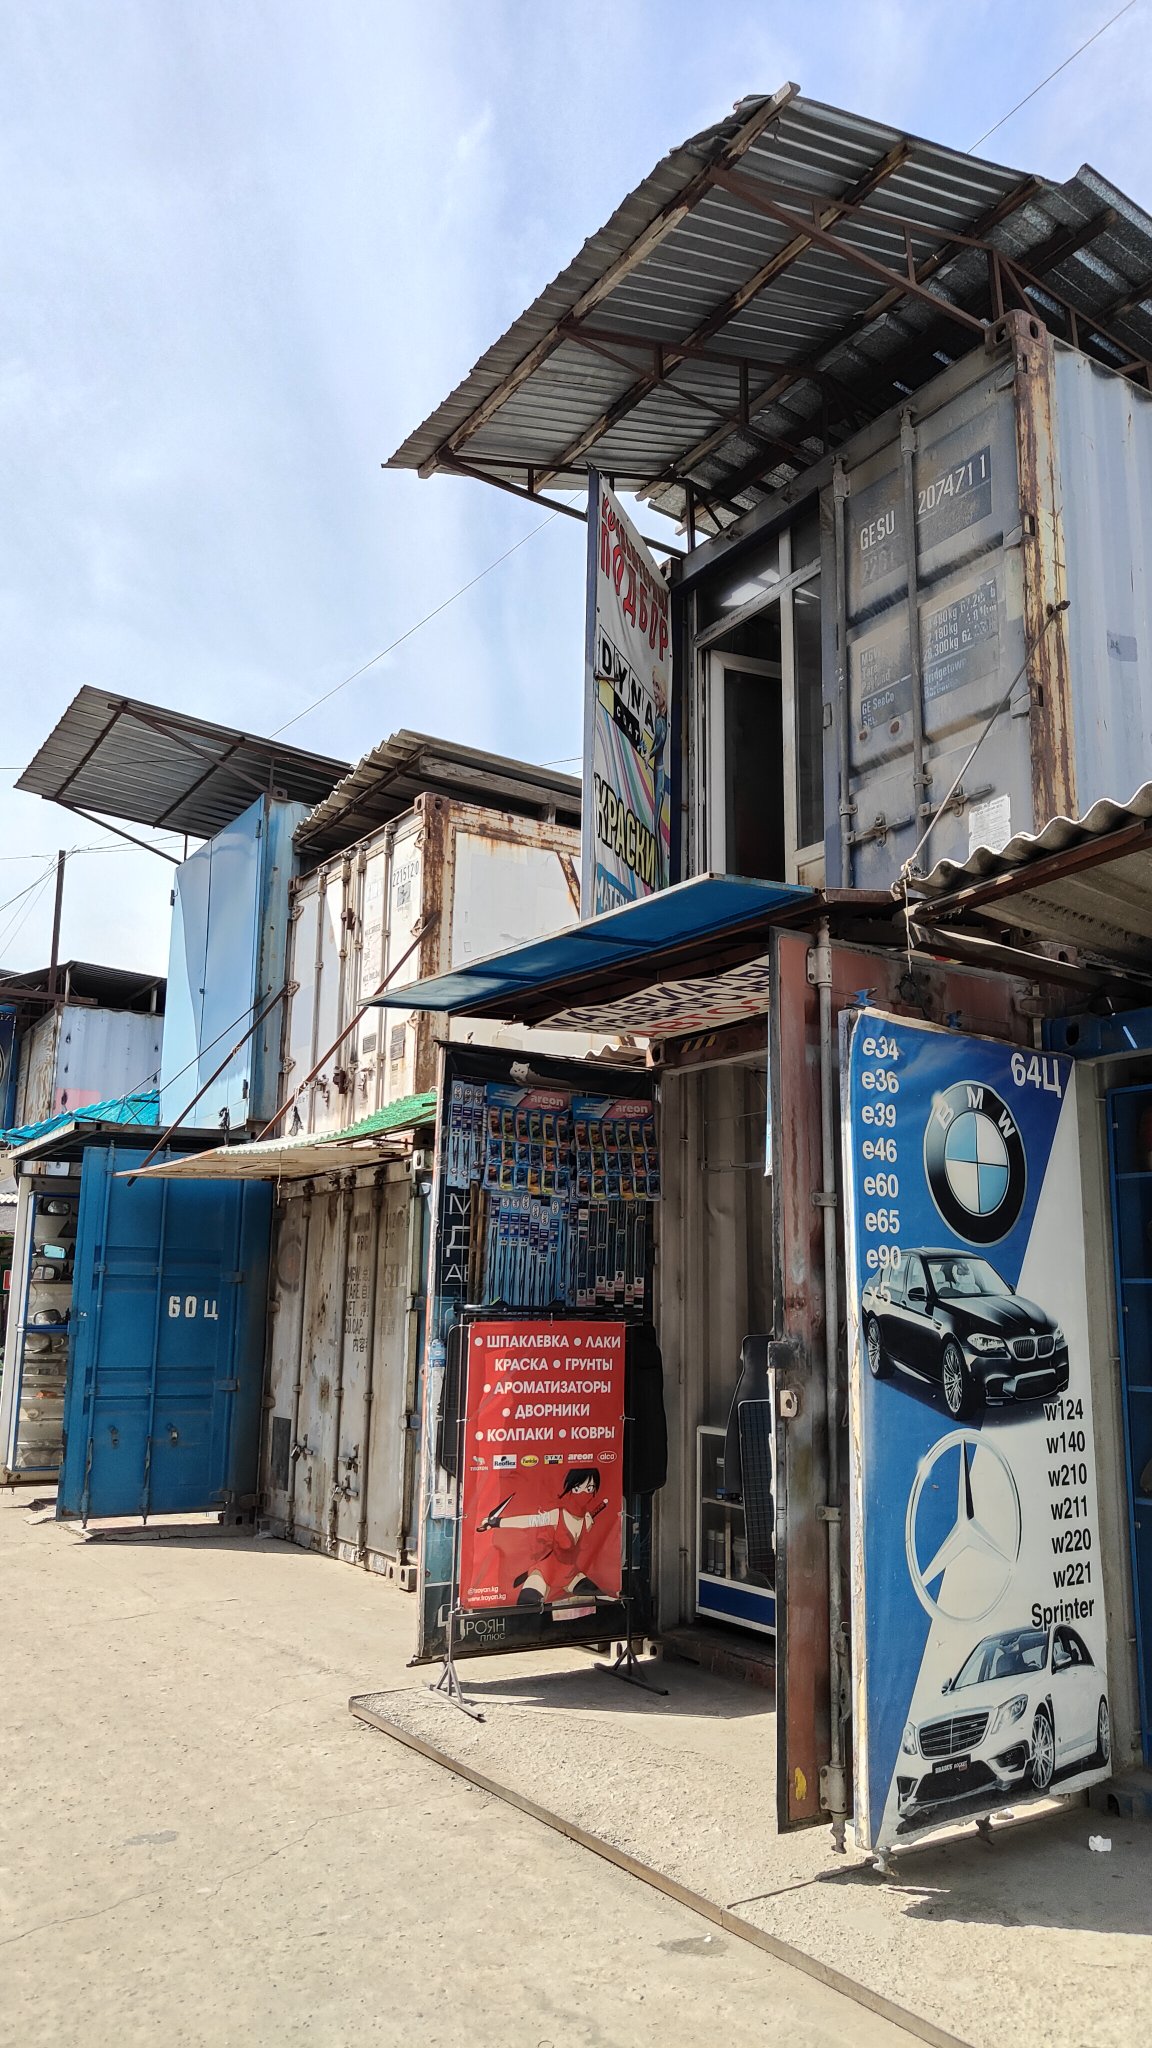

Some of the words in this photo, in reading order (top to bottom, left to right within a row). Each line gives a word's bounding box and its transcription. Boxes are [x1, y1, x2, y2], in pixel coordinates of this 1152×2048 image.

[860, 510, 895, 551] GESU
[601, 521, 668, 662] ПОДБОР
[602, 636, 656, 735] DYNA
[593, 771, 657, 893] КРАСКИ
[862, 1035, 900, 1061] e34
[861, 1068, 900, 1094] e36
[1010, 1052, 1062, 1099] 64Ц
[530, 1094, 564, 1107] areon
[615, 1103, 648, 1114] areon
[935, 1086, 1016, 1139] BMW
[861, 1102, 897, 1128] e39
[862, 1137, 898, 1163] e46
[863, 1172, 899, 1199] e60
[865, 1208, 901, 1234] e65
[866, 1244, 901, 1270] e90
[486, 1335, 570, 1349] ШПАКЛЕВКА
[585, 1336, 621, 1349] ЛАКИ
[494, 1357, 549, 1372] КРАСКА
[565, 1358, 613, 1371] ГРУНТЫ
[494, 1380, 611, 1395] АРОМАТИЗАТОРЫ
[515, 1403, 590, 1420] ДВОРНИКИ
[1044, 1398, 1084, 1422] w124
[486, 1427, 554, 1442] КОЛПАКИ
[571, 1426, 615, 1439] КОВРЫ
[1046, 1430, 1086, 1454] w140
[600, 1452, 615, 1460] alco
[1048, 1463, 1087, 1487] w210
[1051, 1495, 1088, 1520] w211
[1051, 1528, 1092, 1554] w220
[1053, 1561, 1092, 1589] w221
[1031, 1598, 1095, 1632] Sprinter
